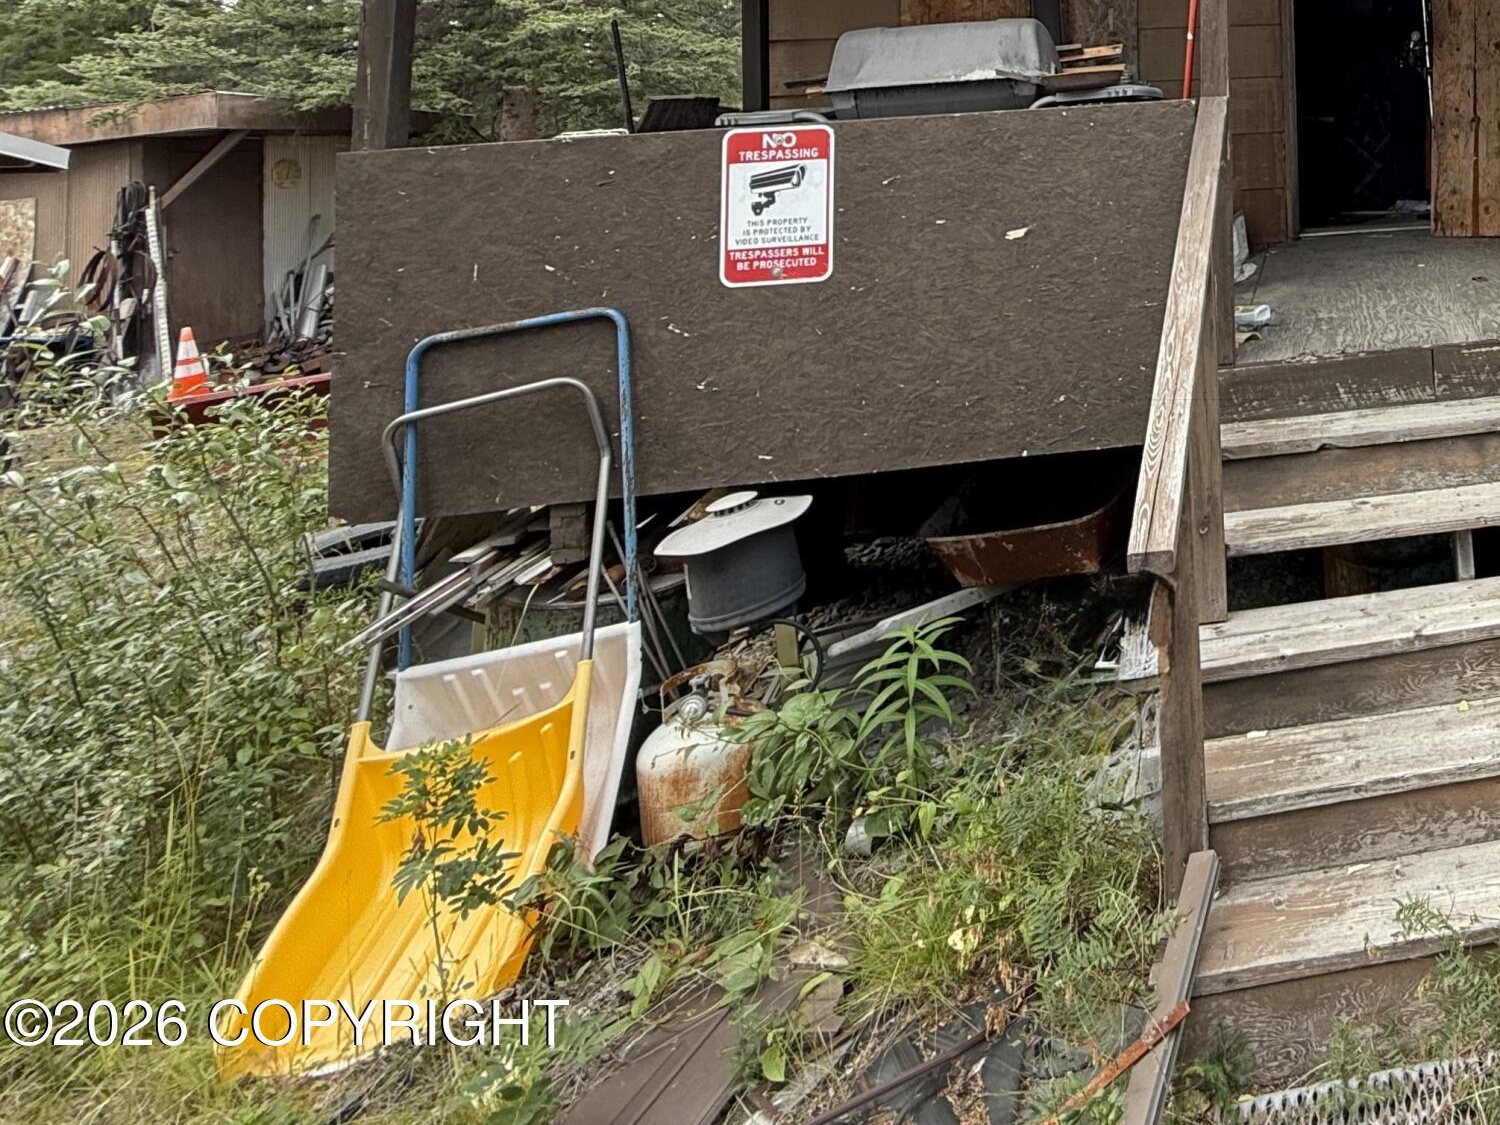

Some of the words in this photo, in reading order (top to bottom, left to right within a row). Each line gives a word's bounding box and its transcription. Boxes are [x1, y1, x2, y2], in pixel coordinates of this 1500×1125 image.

[762, 132, 797, 149] NO
[738, 147, 819, 162] TRESPASSING
[747, 219, 765, 227] THIS
[767, 217, 808, 226] PROPERTY
[743, 228, 751, 236] IS
[753, 226, 798, 236] PROTECTED
[734, 237, 760, 246] VIDEO
[760, 234, 819, 244] SURVEILLANCE
[729, 247, 799, 260] TRESPASSERS
[802, 246, 825, 256] WILL
[736, 261, 750, 271] BE
[753, 257, 817, 269] PROSECUTED
